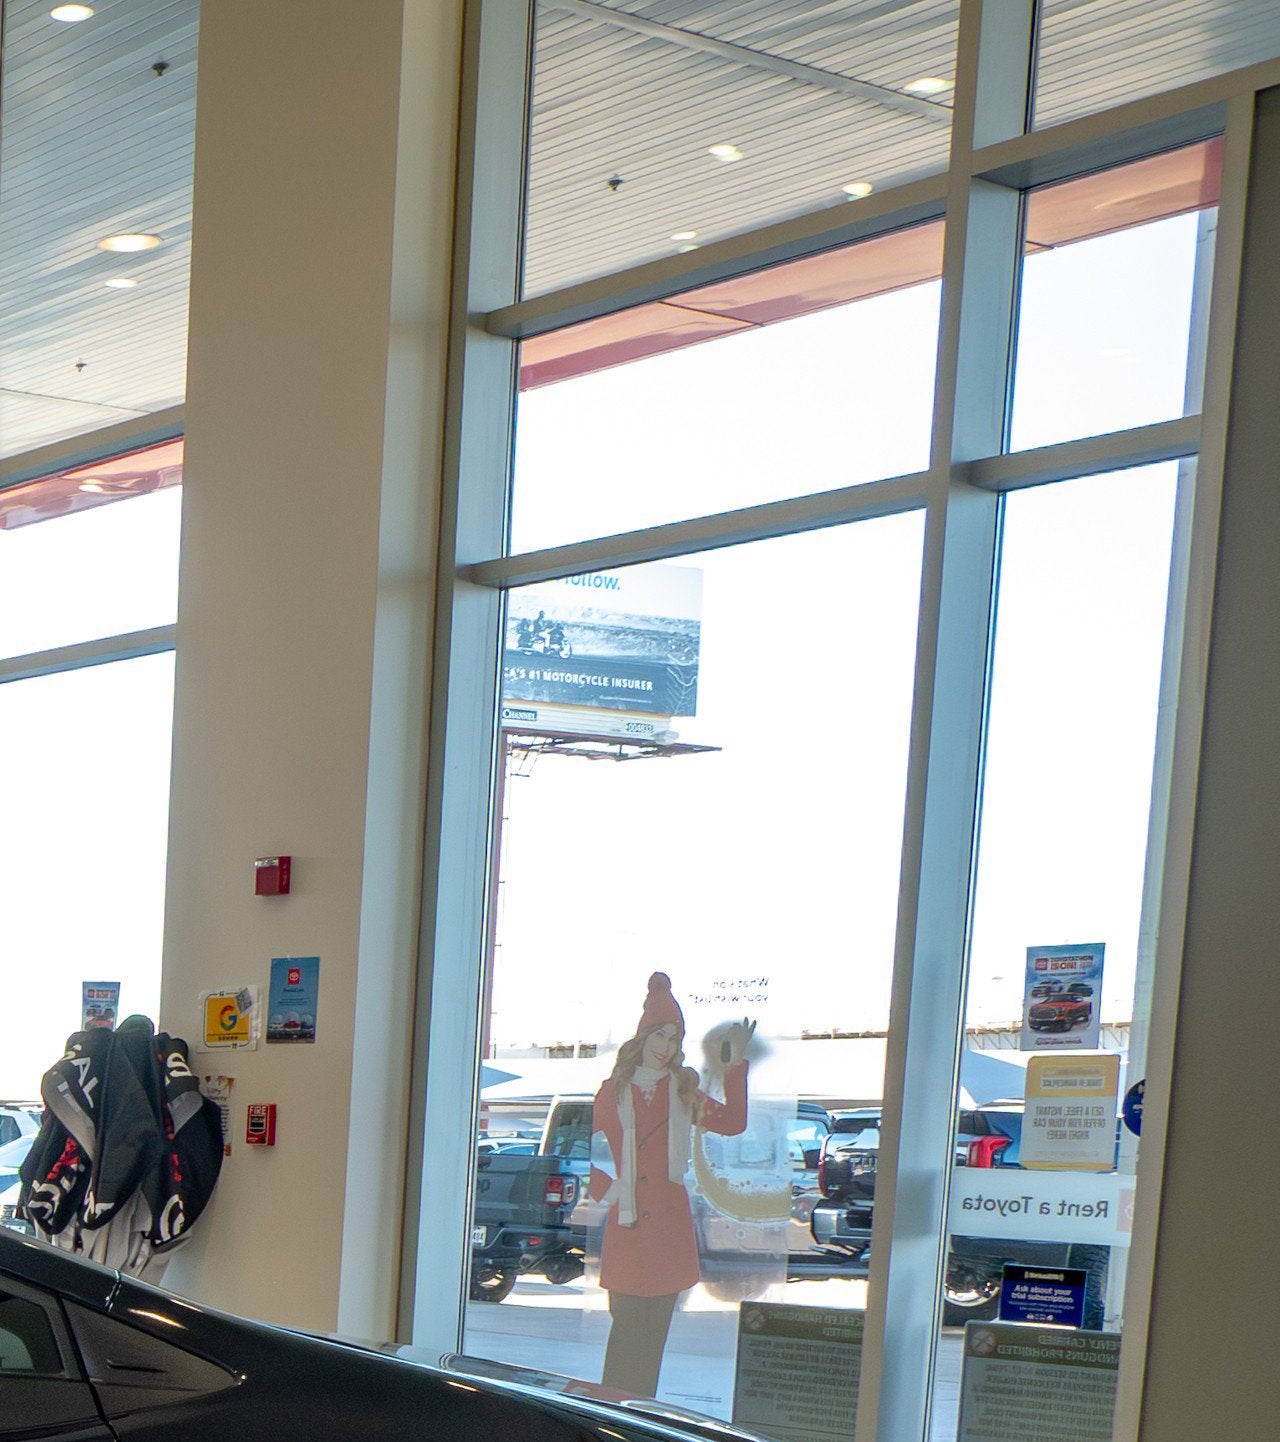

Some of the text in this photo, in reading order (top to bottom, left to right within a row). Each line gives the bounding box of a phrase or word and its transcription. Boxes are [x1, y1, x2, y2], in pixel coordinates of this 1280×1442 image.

[543, 671, 609, 687] MOTORCYCLE
[611, 677, 653, 691] INSURER
[249, 1105, 267, 1115] FIRE
[1013, 1284, 1072, 1296] Ask about your
[1027, 1294, 1074, 1303] subscription
